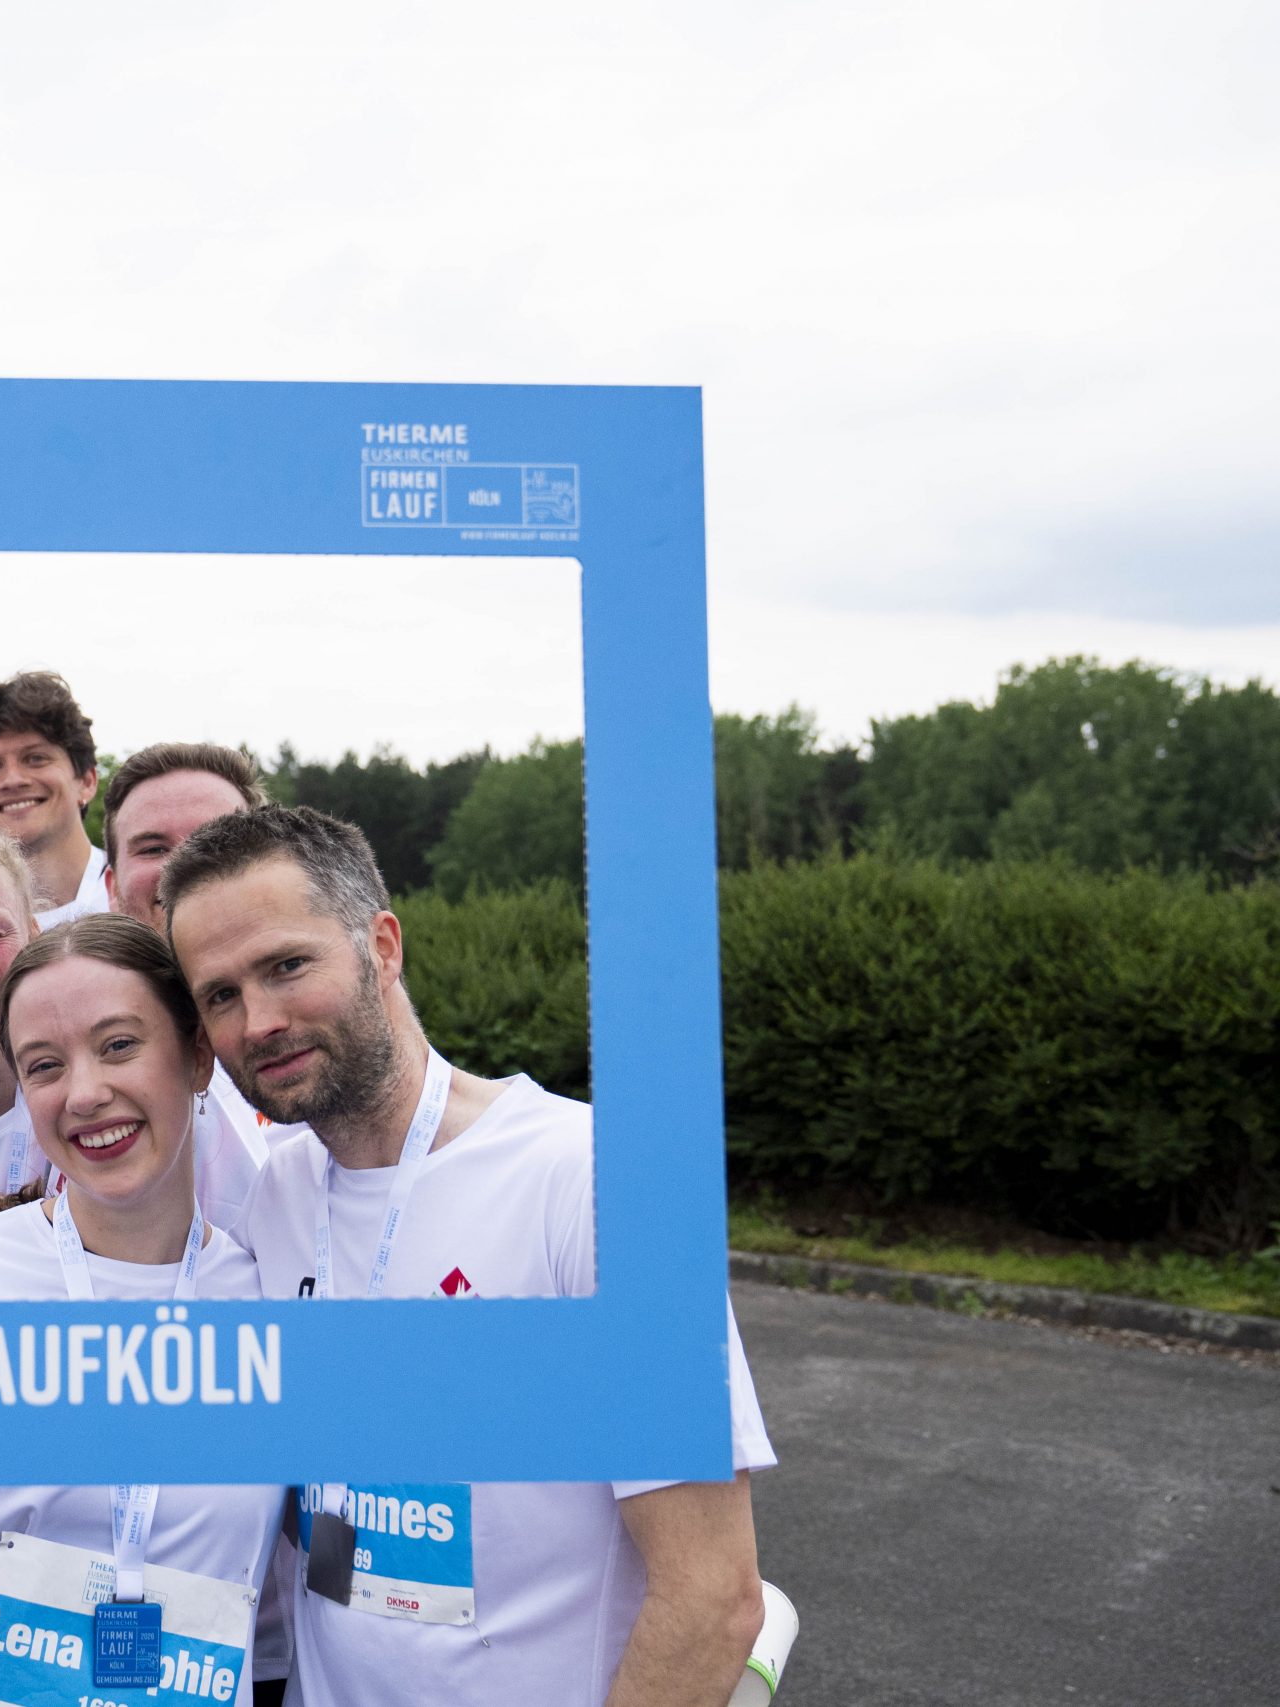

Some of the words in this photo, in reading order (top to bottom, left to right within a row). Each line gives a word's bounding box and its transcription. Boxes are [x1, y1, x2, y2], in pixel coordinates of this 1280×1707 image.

[361, 423, 468, 445] THERME
[361, 447, 470, 464] EUSKIRCHEN
[370, 470, 438, 489] FIRMEN
[370, 491, 437, 519] LAUF
[468, 487, 501, 507] KÖLN
[300, 1482, 455, 1543] Joannes
[128, 1511, 140, 1544] THERME
[90, 1561, 116, 1574] THER
[89, 1579, 113, 1592] FIRMEN
[386, 1596, 411, 1610] DKMS
[97, 1610, 138, 1620] THERME
[101, 1630, 134, 1641] FIRMEN
[101, 1641, 133, 1656] LAUF
[96, 1675, 132, 1685] GEMEINSAM
[147, 1649, 235, 1702] phie
